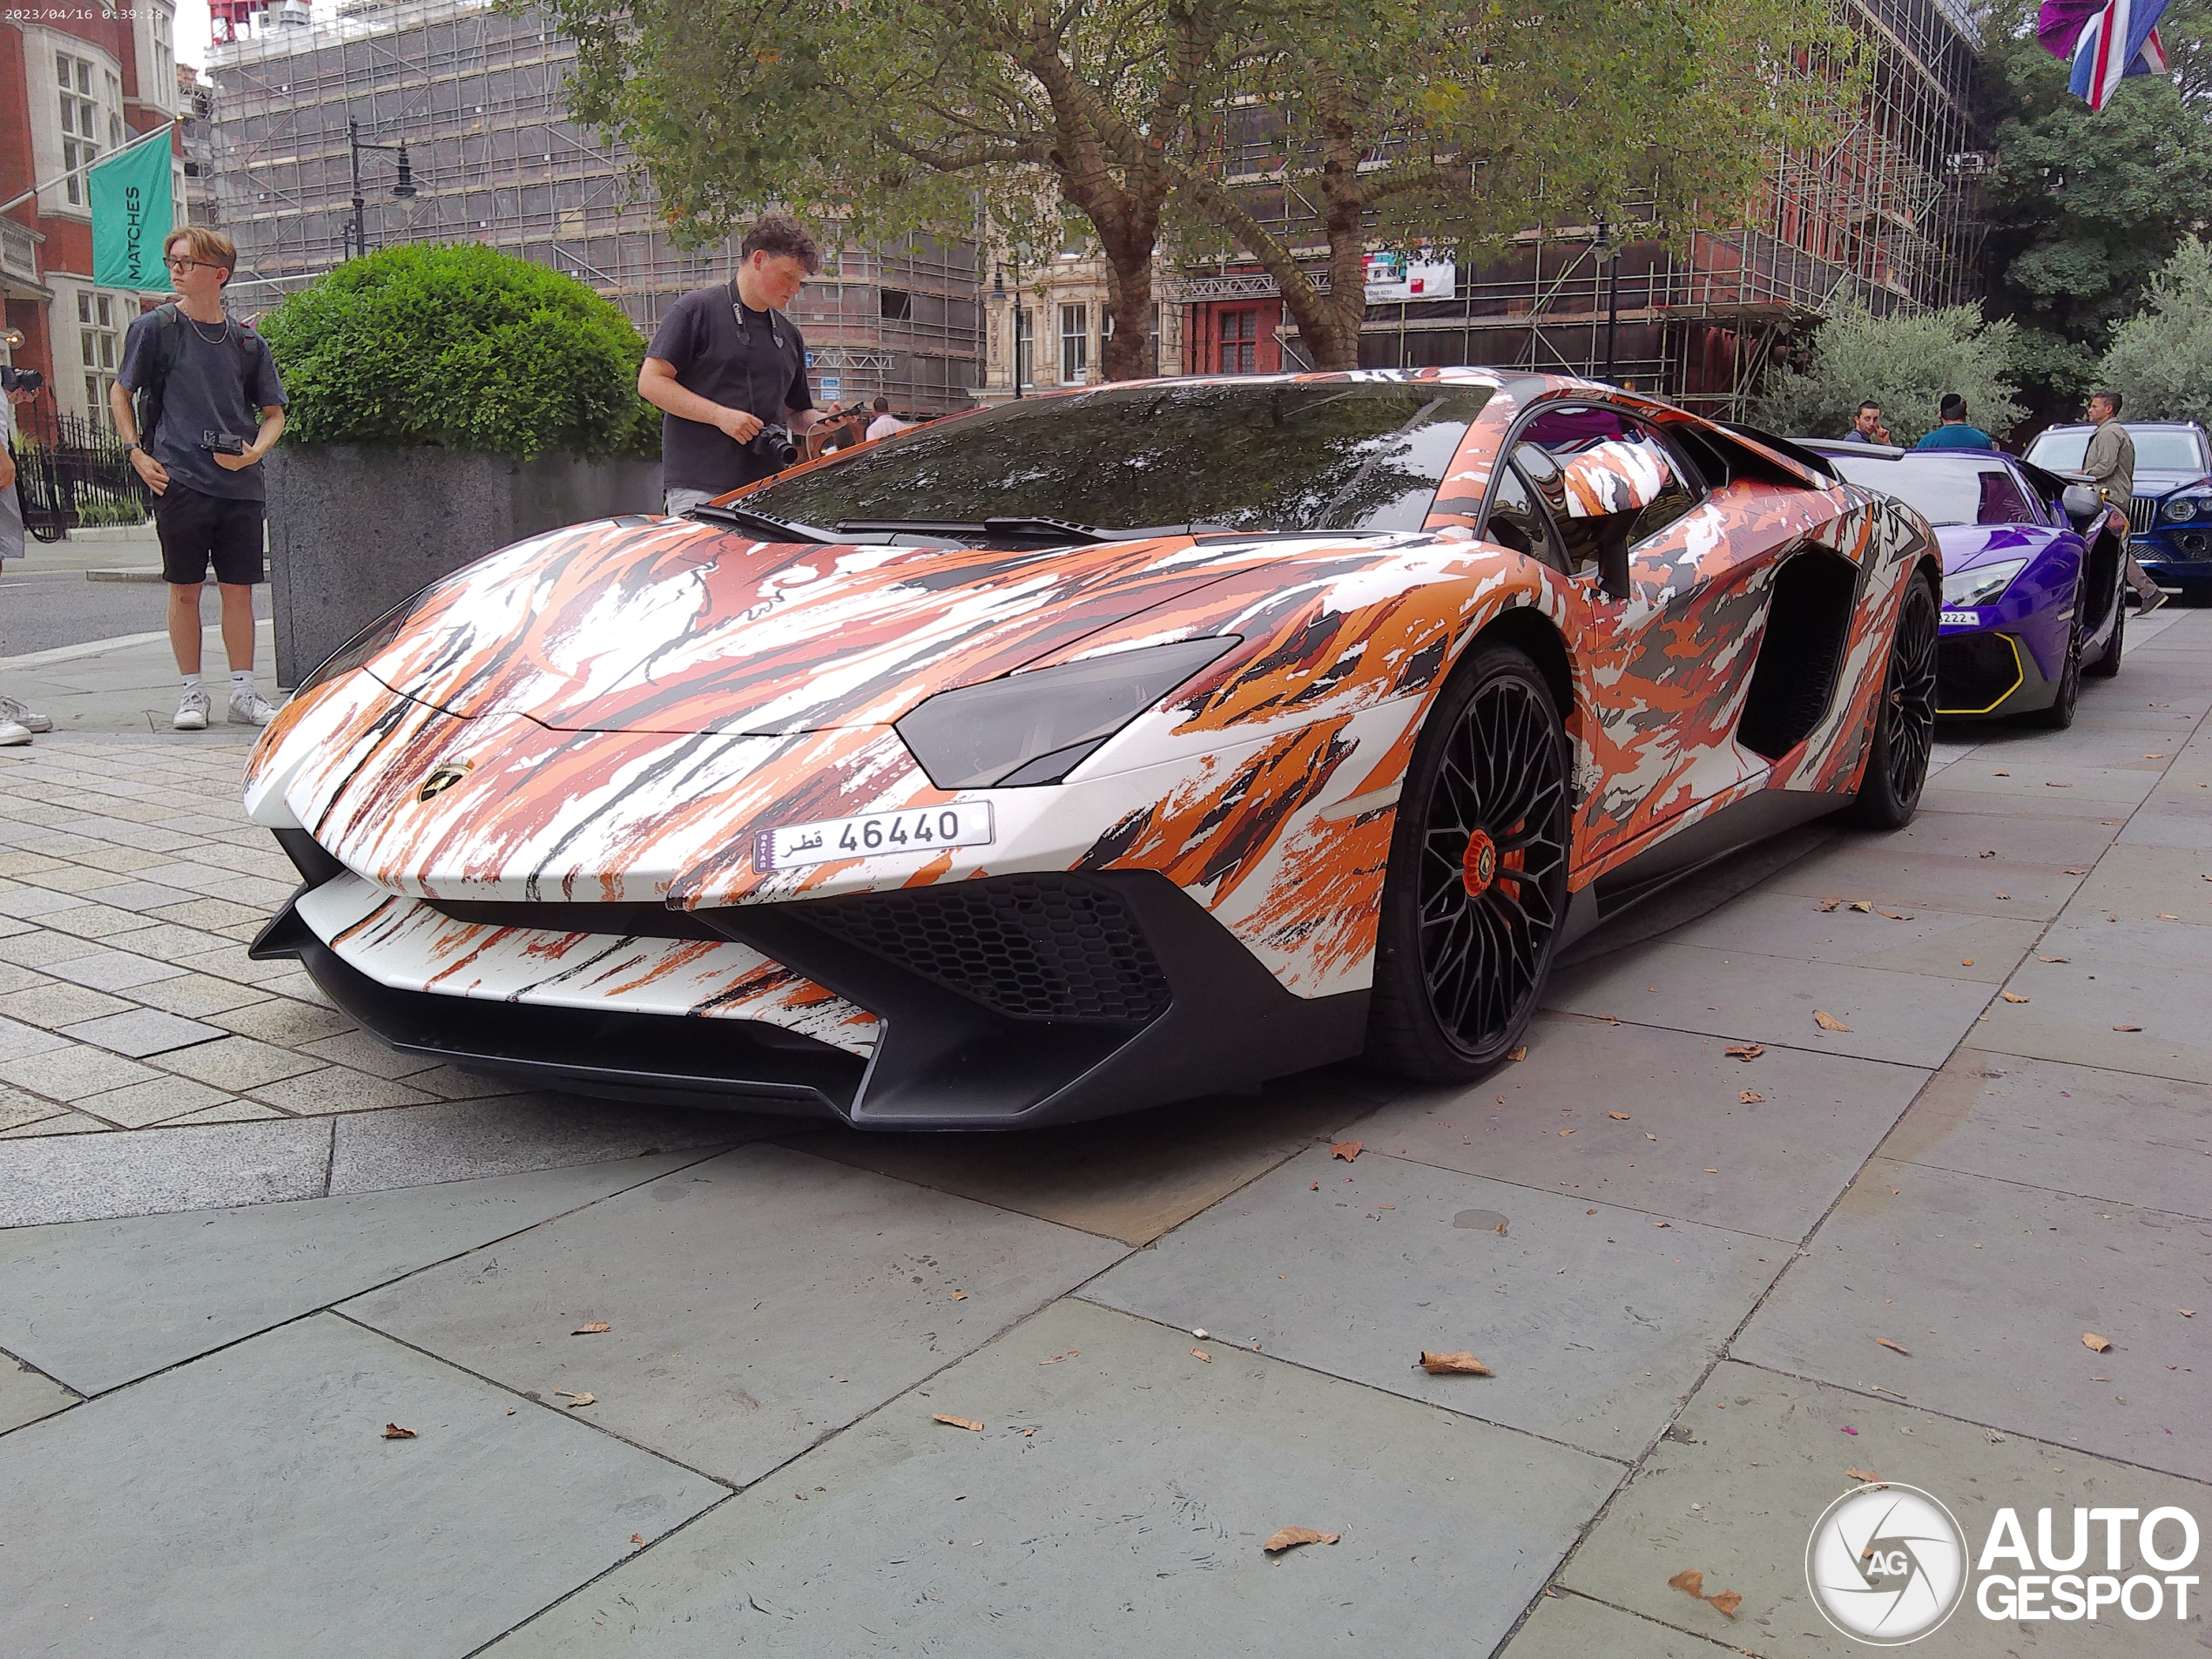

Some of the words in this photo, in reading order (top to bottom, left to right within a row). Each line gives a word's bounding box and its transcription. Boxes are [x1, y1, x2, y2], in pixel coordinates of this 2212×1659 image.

[126, 186, 141, 280] MATCHES
[780, 830, 823, 858] قطر
[839, 811, 959, 852] 46440
[759, 834, 768, 869] QATAR
